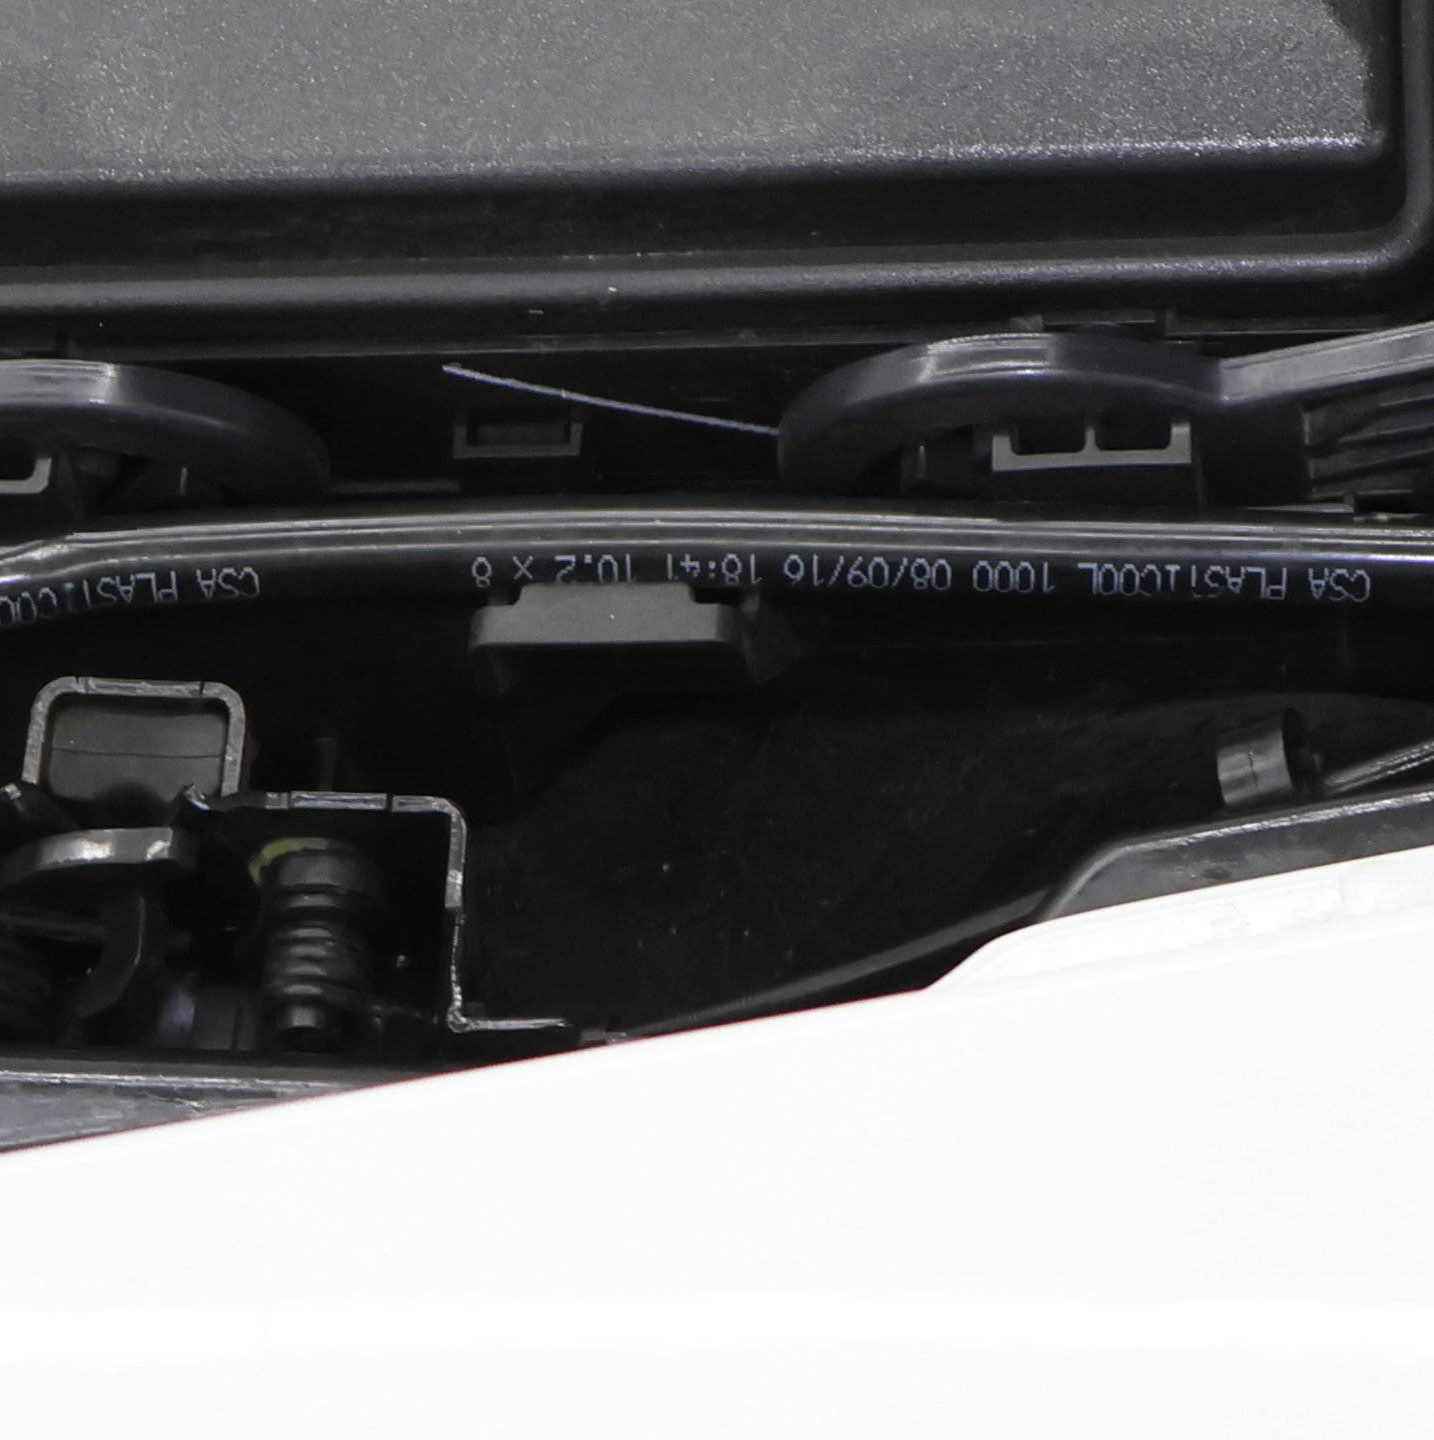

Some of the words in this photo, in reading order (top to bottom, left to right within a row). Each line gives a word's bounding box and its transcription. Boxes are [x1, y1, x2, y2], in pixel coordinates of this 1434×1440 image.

[195, 567, 261, 600] CSA
[471, 556, 492, 586] 8
[554, 553, 638, 585] 10.2
[664, 551, 763, 585] 18:41
[782, 553, 952, 590] 08/09/16
[971, 558, 1055, 594] 1000
[1308, 567, 1370, 602] CSA
